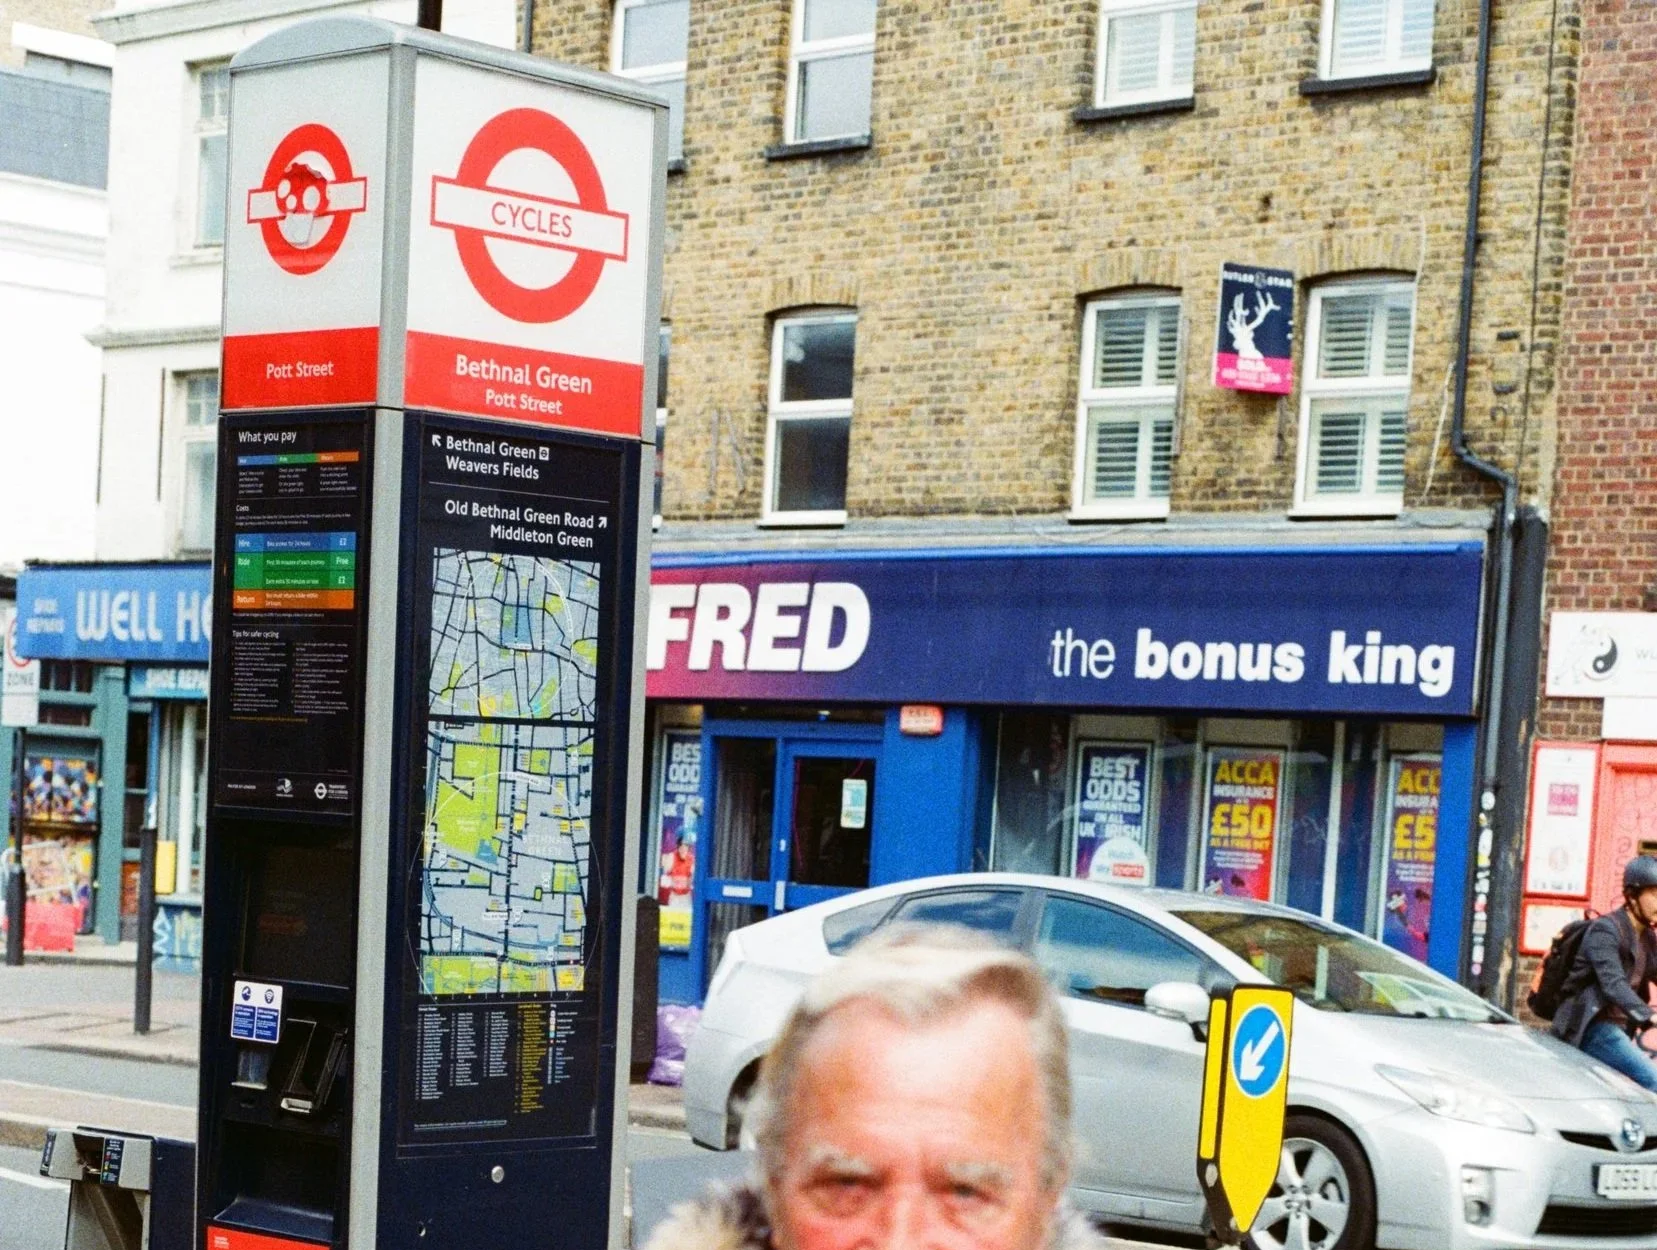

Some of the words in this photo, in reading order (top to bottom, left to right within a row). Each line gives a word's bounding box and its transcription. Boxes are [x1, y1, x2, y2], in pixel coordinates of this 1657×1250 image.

[491, 201, 573, 239] CYCLES
[266, 362, 293, 379] Pott
[296, 360, 334, 378] Street
[455, 353, 532, 385] Bethnal
[536, 366, 592, 394] Green
[485, 388, 516, 407] Pott
[519, 392, 563, 415] Street
[238, 431, 262, 443] What
[263, 432, 279, 444] you
[281, 431, 297, 443] pay
[446, 435, 496, 455] Bethnal
[499, 442, 536, 460] Green
[445, 455, 499, 475] Weavers
[503, 462, 539, 480] Fields
[445, 500, 468, 516] Old
[472, 503, 520, 521] Bethnal
[523, 508, 560, 525] Green
[564, 512, 594, 529] Road
[490, 524, 554, 545] Middleton
[557, 531, 593, 548] Green
[76, 590, 163, 642] WELL
[645, 581, 871, 672] FRED
[1050, 627, 1116, 679] the
[1135, 628, 1305, 683] bonus
[1328, 630, 1455, 698] king
[1090, 756, 1140, 779] BEST
[1215, 760, 1275, 785] ACCA
[1086, 778, 1141, 802] ODDS
[1079, 822, 1096, 838] UK
[1210, 803, 1272, 839] £50
